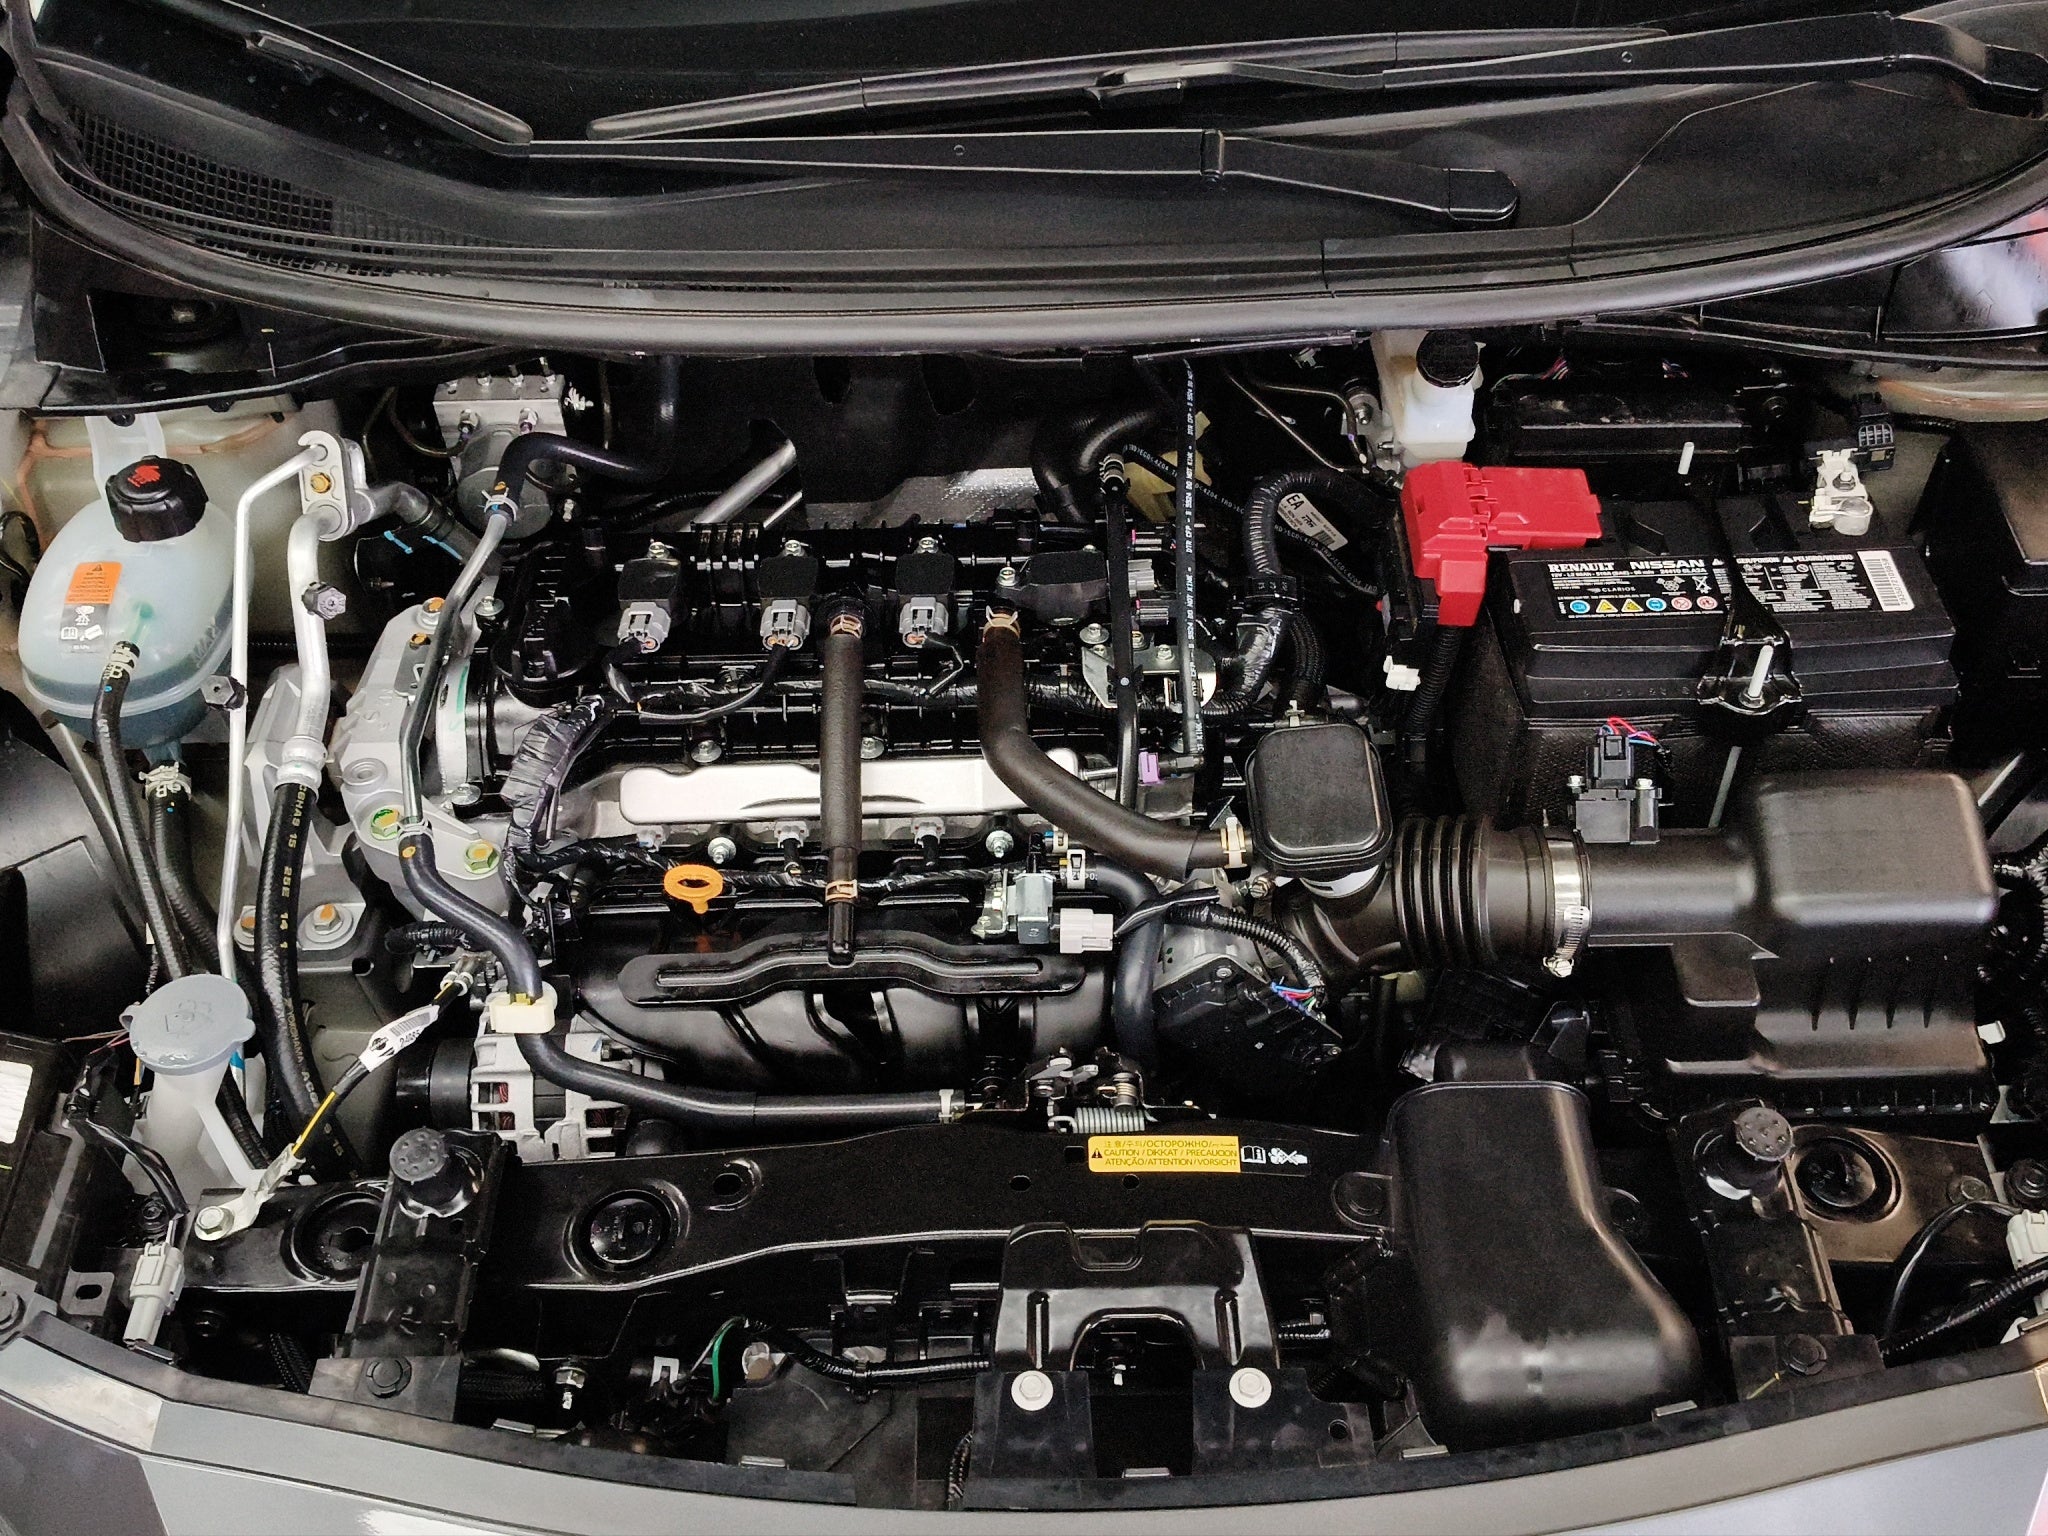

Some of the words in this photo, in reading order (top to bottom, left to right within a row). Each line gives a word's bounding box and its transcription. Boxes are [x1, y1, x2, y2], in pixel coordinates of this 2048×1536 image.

[1286, 494, 1305, 510] EA
[1548, 562, 1614, 573] RENAULT
[1630, 559, 1705, 570] NISSAN
[286, 1010, 305, 1064] YOKOHAMA
